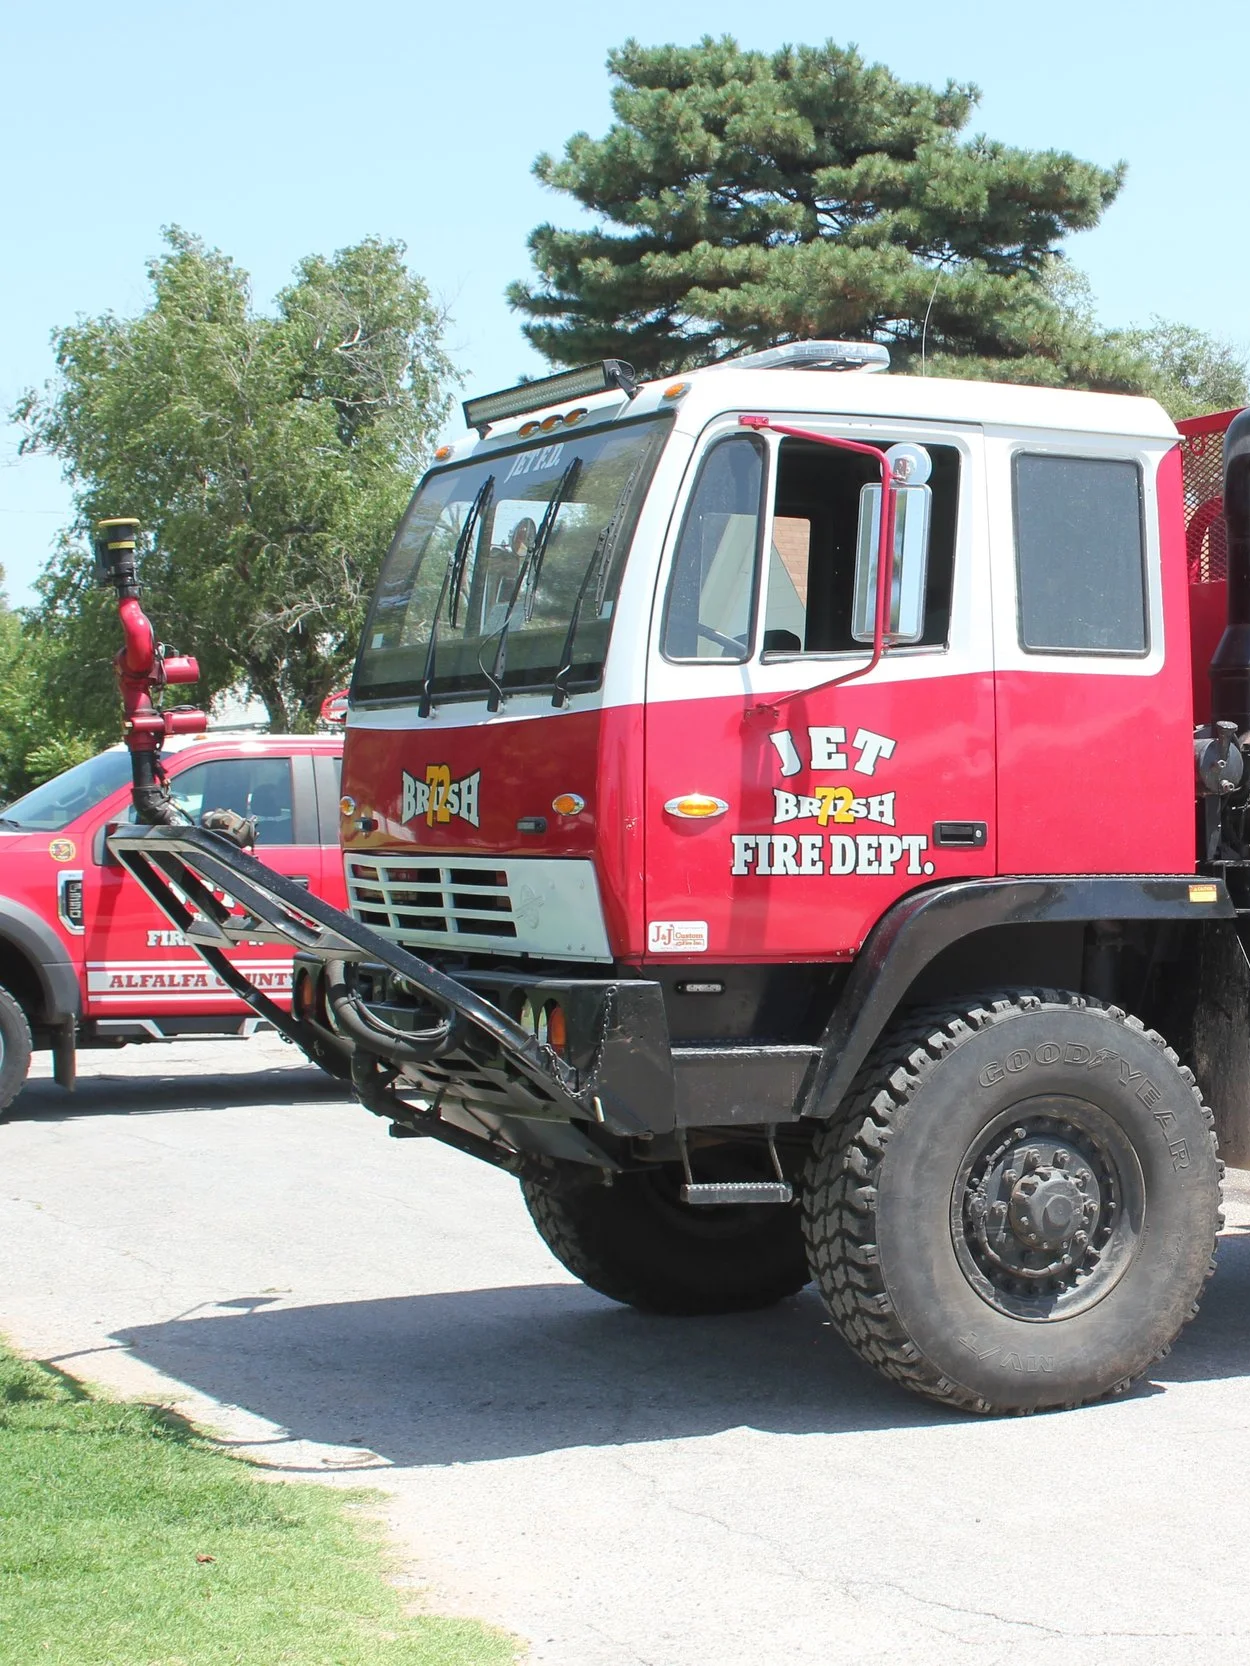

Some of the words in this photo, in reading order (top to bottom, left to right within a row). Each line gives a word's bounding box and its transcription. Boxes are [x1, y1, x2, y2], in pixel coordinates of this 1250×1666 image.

[768, 725, 897, 777] JET
[401, 770, 481, 828] BRUSH
[426, 764, 450, 828] 72
[772, 787, 897, 827] BRUSH
[814, 785, 855, 827] 72
[731, 834, 825, 876] FIRE
[829, 834, 936, 876] DEPT.
[147, 929, 190, 947] FIR
[651, 925, 673, 946] J&J
[109, 973, 209, 988] ALFALFA
[977, 1041, 1193, 1173] GOODYEAR
[958, 1330, 1055, 1374] MV/T
